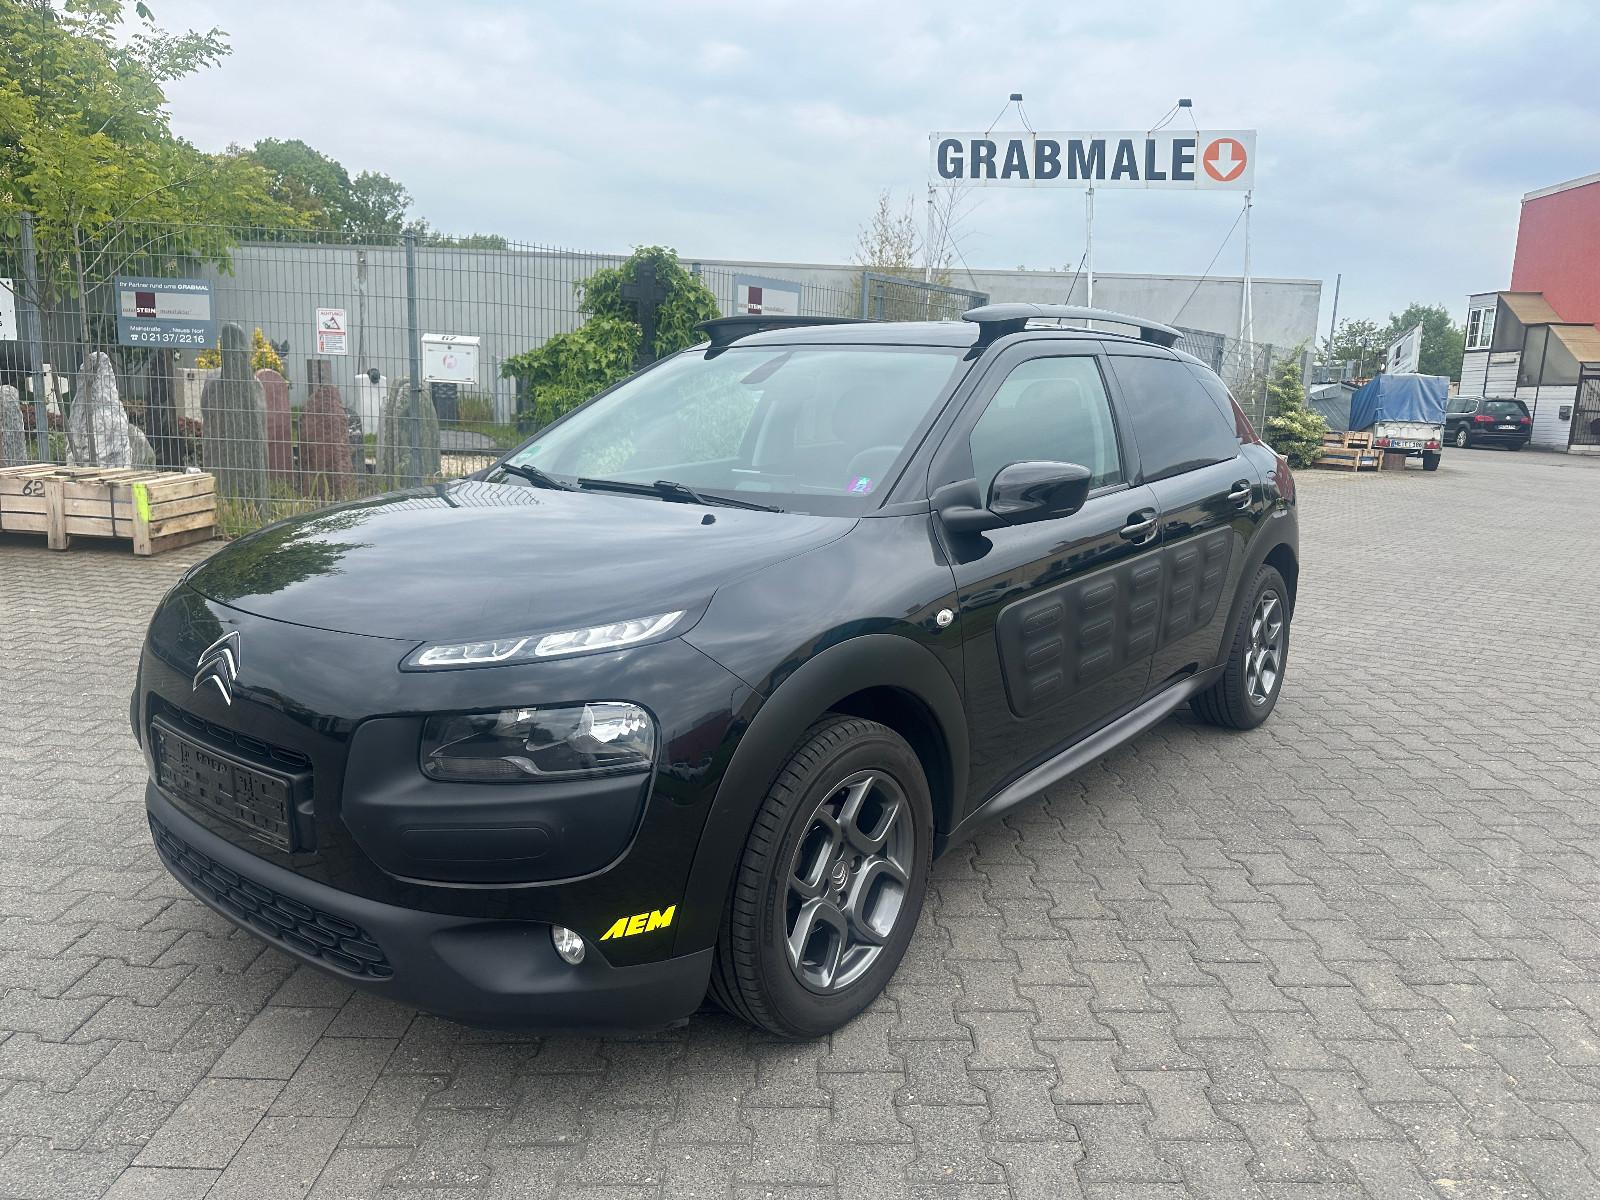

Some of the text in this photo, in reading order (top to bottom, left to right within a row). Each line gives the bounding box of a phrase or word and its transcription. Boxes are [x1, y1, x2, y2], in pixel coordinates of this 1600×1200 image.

[937, 138, 1196, 181] GRABMALE
[22, 480, 45, 496] 62
[599, 904, 677, 941] AEM
